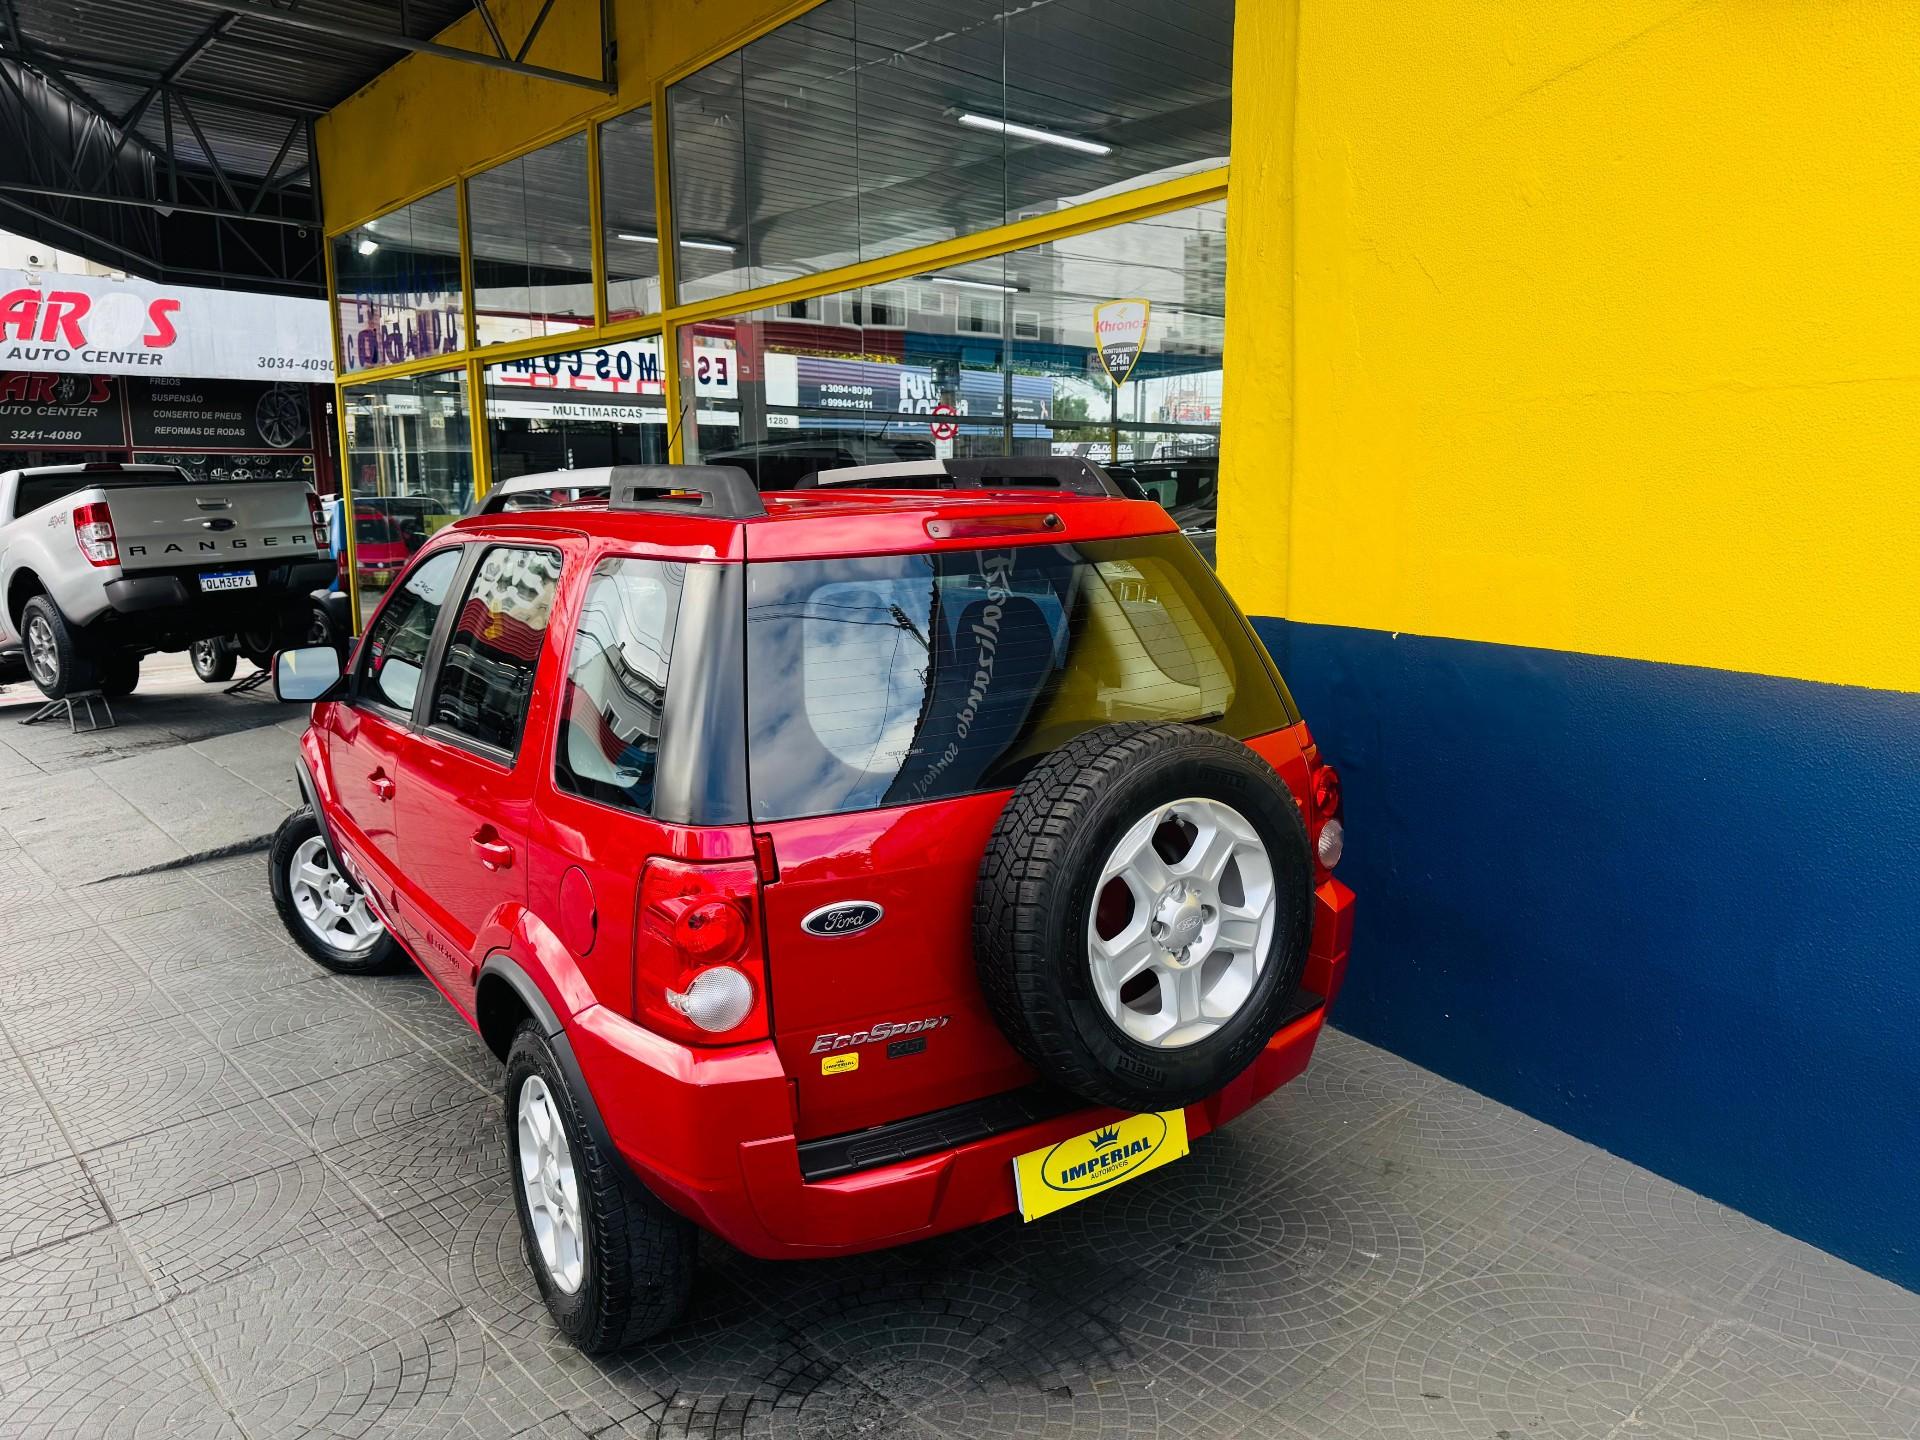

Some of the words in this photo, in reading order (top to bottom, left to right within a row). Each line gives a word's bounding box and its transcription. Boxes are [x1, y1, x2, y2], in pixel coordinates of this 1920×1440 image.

[1096, 320, 1148, 333] Khronos
[7, 347, 71, 361] AUTO
[82, 350, 163, 365] CENTER
[1111, 354, 1130, 366] 24h
[258, 357, 335, 372] 3034-4090
[149, 377, 181, 386] FREIOS
[36, 406, 98, 417] CENTER
[153, 410, 200, 419] CONSERTO
[201, 411, 213, 419] DE
[214, 412, 242, 420] PNEUS
[552, 405, 643, 418] MULTIMARCAS
[10, 430, 82, 440] 3241-4080
[154, 426, 202, 435] REFORMAS
[203, 427, 215, 436] DE
[216, 428, 246, 436] RODAS
[129, 535, 306, 556] RANGER
[206, 576, 251, 589] QLM3E76
[824, 908, 865, 931] Ford
[1061, 1137, 1152, 1184] IMPERIAL
